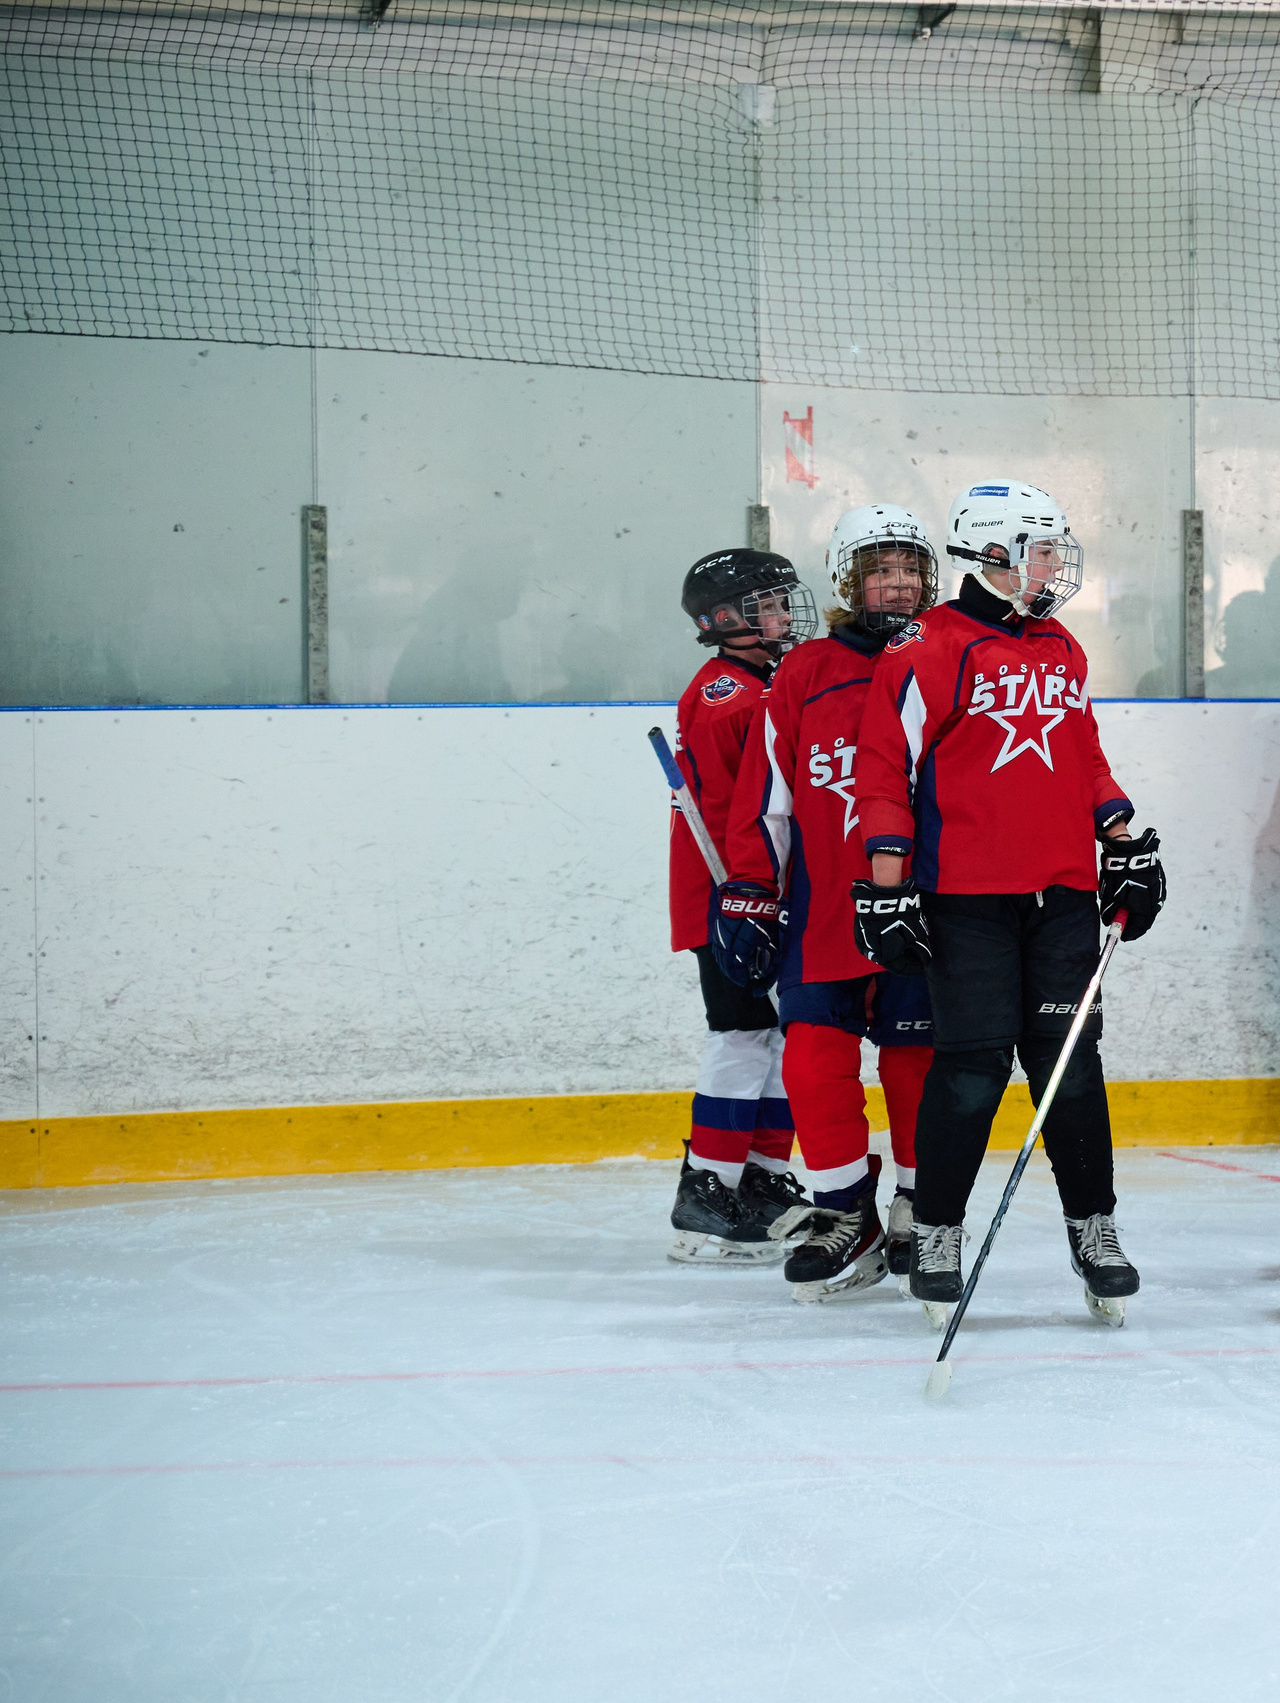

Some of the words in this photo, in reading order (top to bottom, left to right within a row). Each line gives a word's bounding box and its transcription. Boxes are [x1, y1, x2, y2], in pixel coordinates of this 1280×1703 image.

[971, 520, 1004, 528] BAUER
[694, 554, 733, 575] CCM
[975, 554, 1001, 565] BAUER
[974, 663, 1067, 685] BOSTO
[967, 669, 1084, 716] STARS
[856, 893, 921, 914] CCM
[896, 1020, 932, 1031] CC
[842, 1235, 861, 1264] CCM
